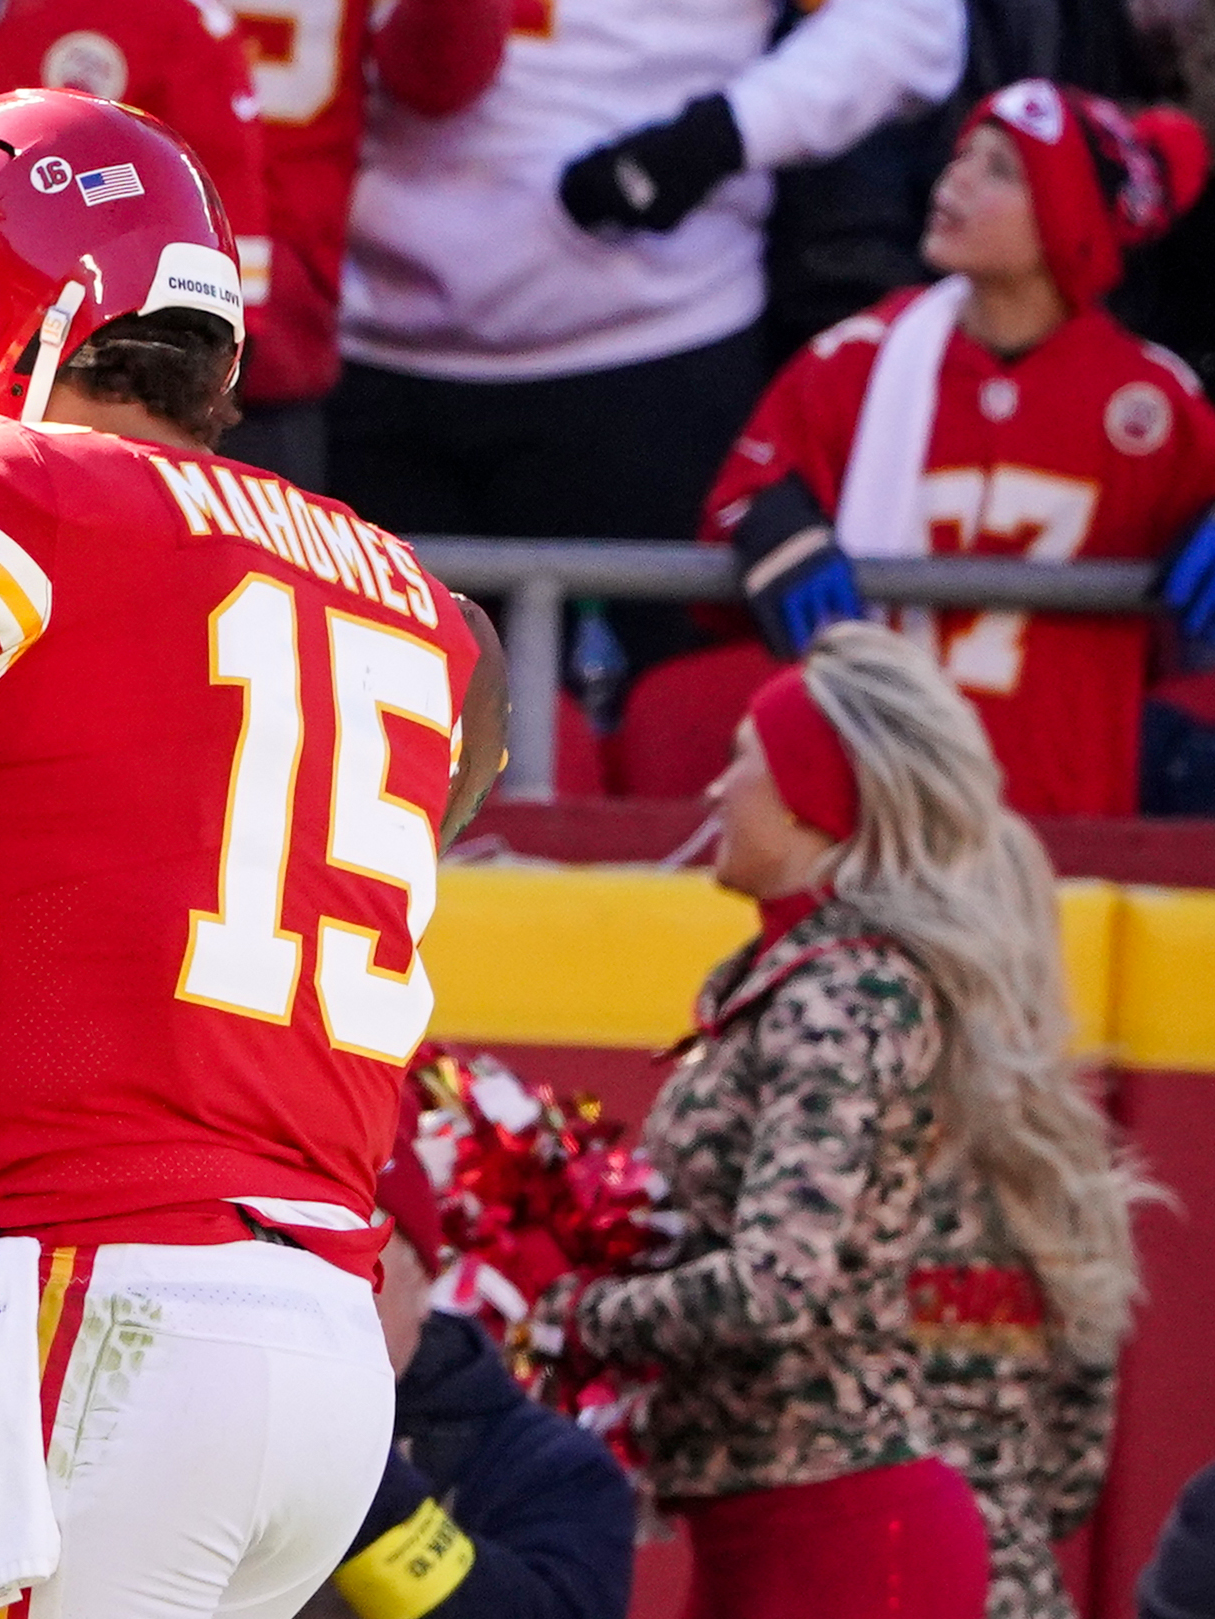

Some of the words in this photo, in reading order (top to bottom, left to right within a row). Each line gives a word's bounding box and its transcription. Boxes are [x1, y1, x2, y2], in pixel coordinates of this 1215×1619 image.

[36, 160, 68, 190] 16
[169, 276, 217, 298] CHOOSE
[149, 456, 439, 630] MAHOMES
[174, 571, 453, 1068] 15
